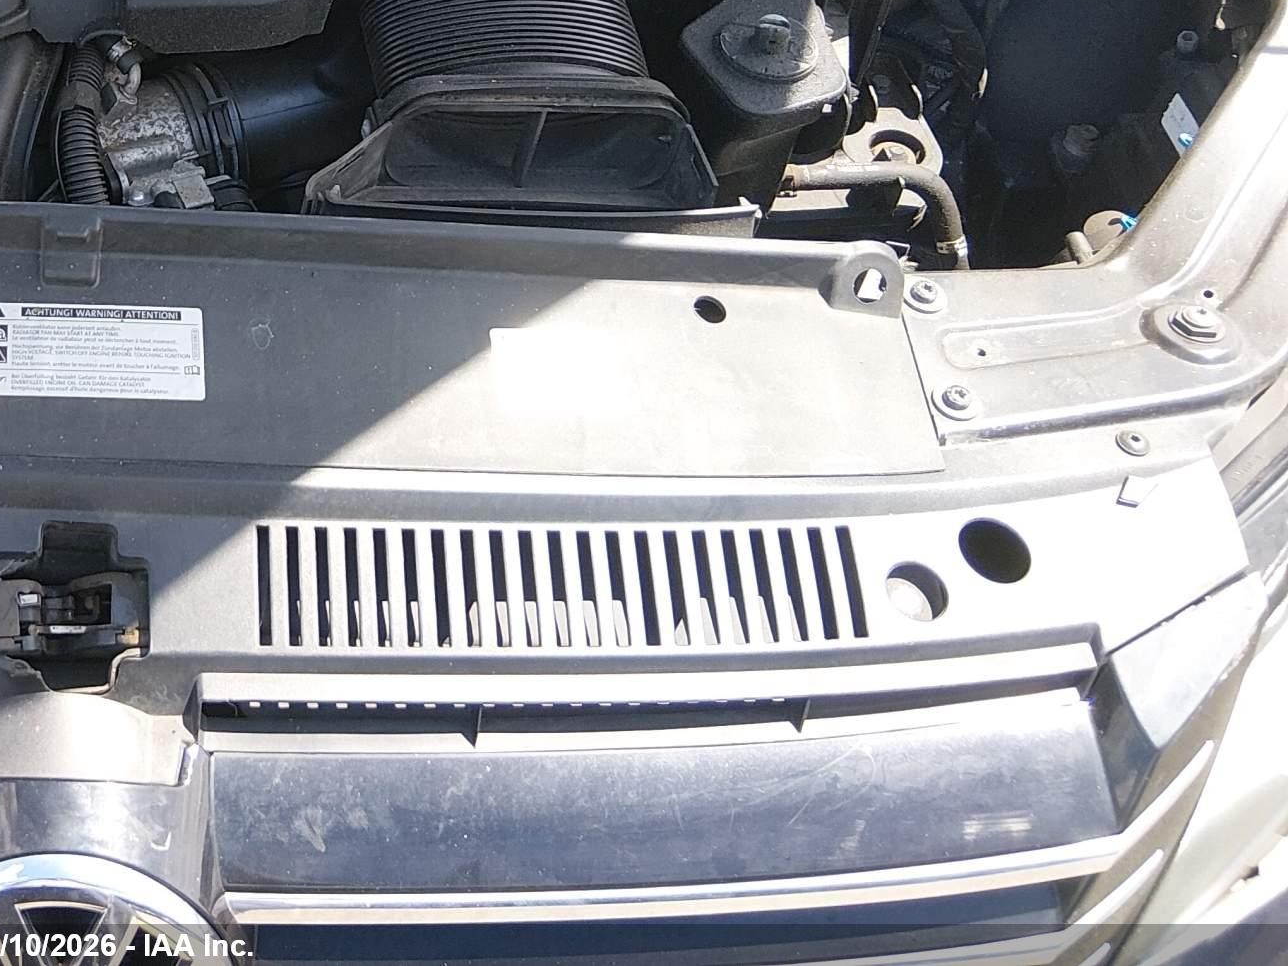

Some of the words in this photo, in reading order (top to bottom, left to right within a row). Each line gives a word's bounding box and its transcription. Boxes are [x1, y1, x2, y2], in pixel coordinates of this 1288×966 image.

[24, 308, 73, 318] ACHTUNG!
[75, 309, 124, 319] WARNING!
[125, 310, 179, 320] ATTENTION!
